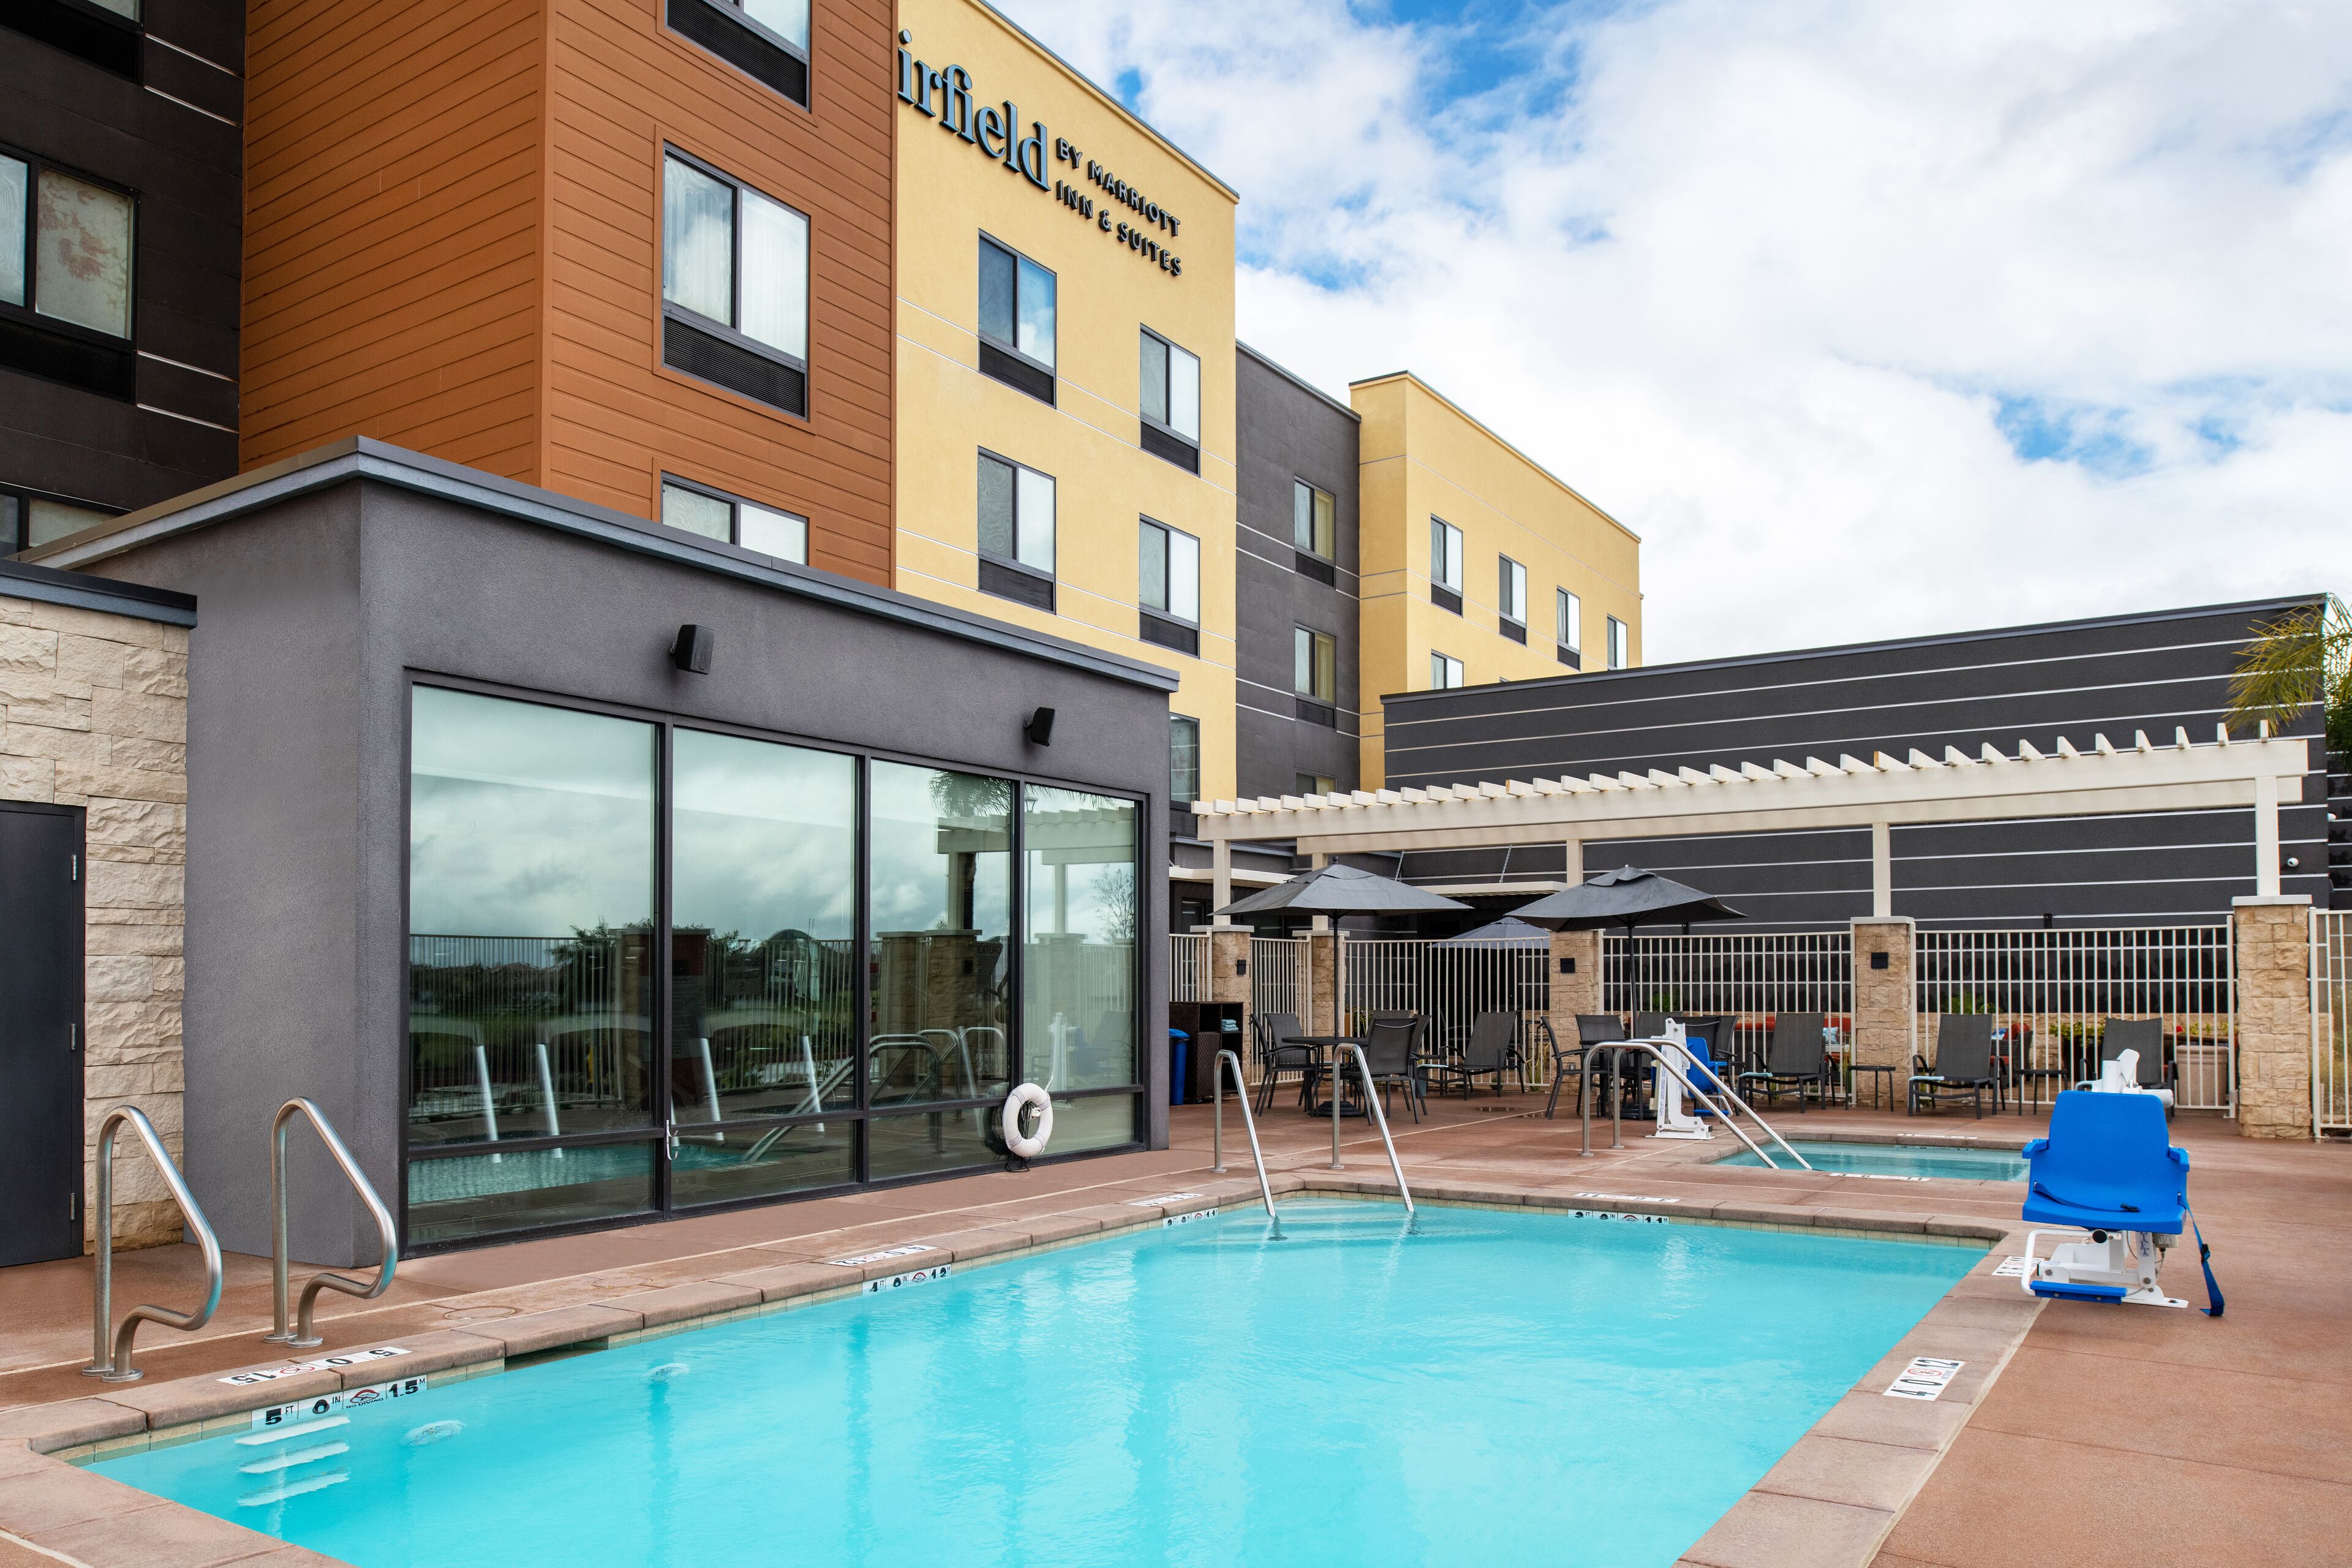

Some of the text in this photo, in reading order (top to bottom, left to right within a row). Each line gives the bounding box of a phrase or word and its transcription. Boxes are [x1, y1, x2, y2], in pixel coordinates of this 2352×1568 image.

[1056, 137, 1180, 236] BY MARRIOTT
[1056, 180, 1182, 276] INN & SUITES
[870, 1281, 879, 1292] 4
[388, 1379, 419, 1398] 1.5
[265, 1395, 341, 1425] 5 FT 0 IN
[358, 1398, 384, 1406] DIVING
